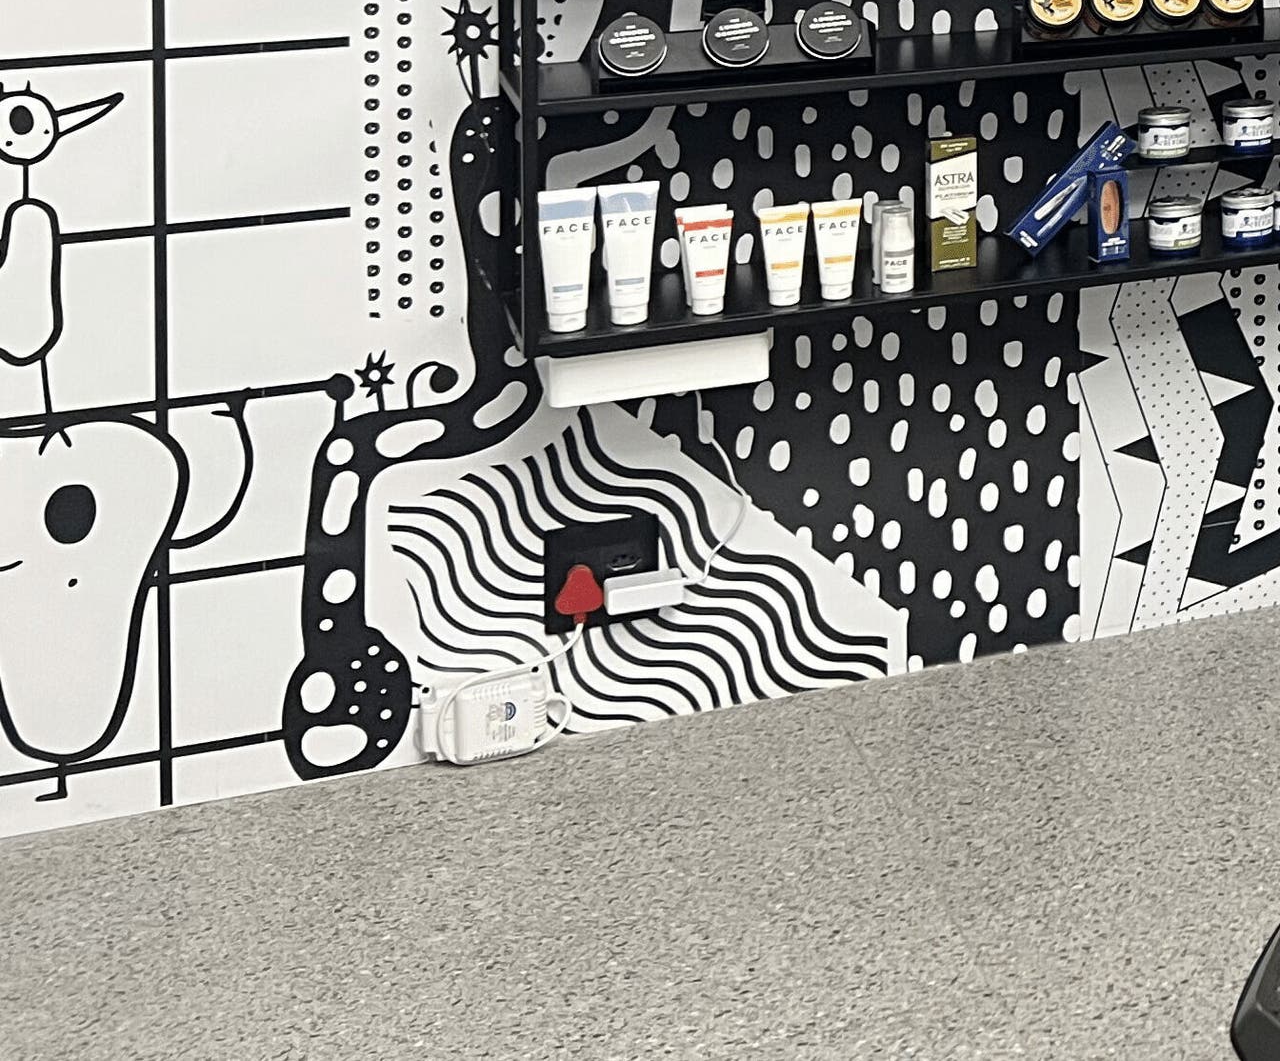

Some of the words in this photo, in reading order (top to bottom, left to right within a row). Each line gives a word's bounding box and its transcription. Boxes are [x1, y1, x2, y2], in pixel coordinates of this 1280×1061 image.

[934, 172, 974, 186] ASTRA
[543, 222, 590, 235] FACE
[606, 216, 653, 229] FACE
[818, 220, 857, 231] FACE
[764, 225, 805, 237] FACE
[689, 232, 729, 244] FACE
